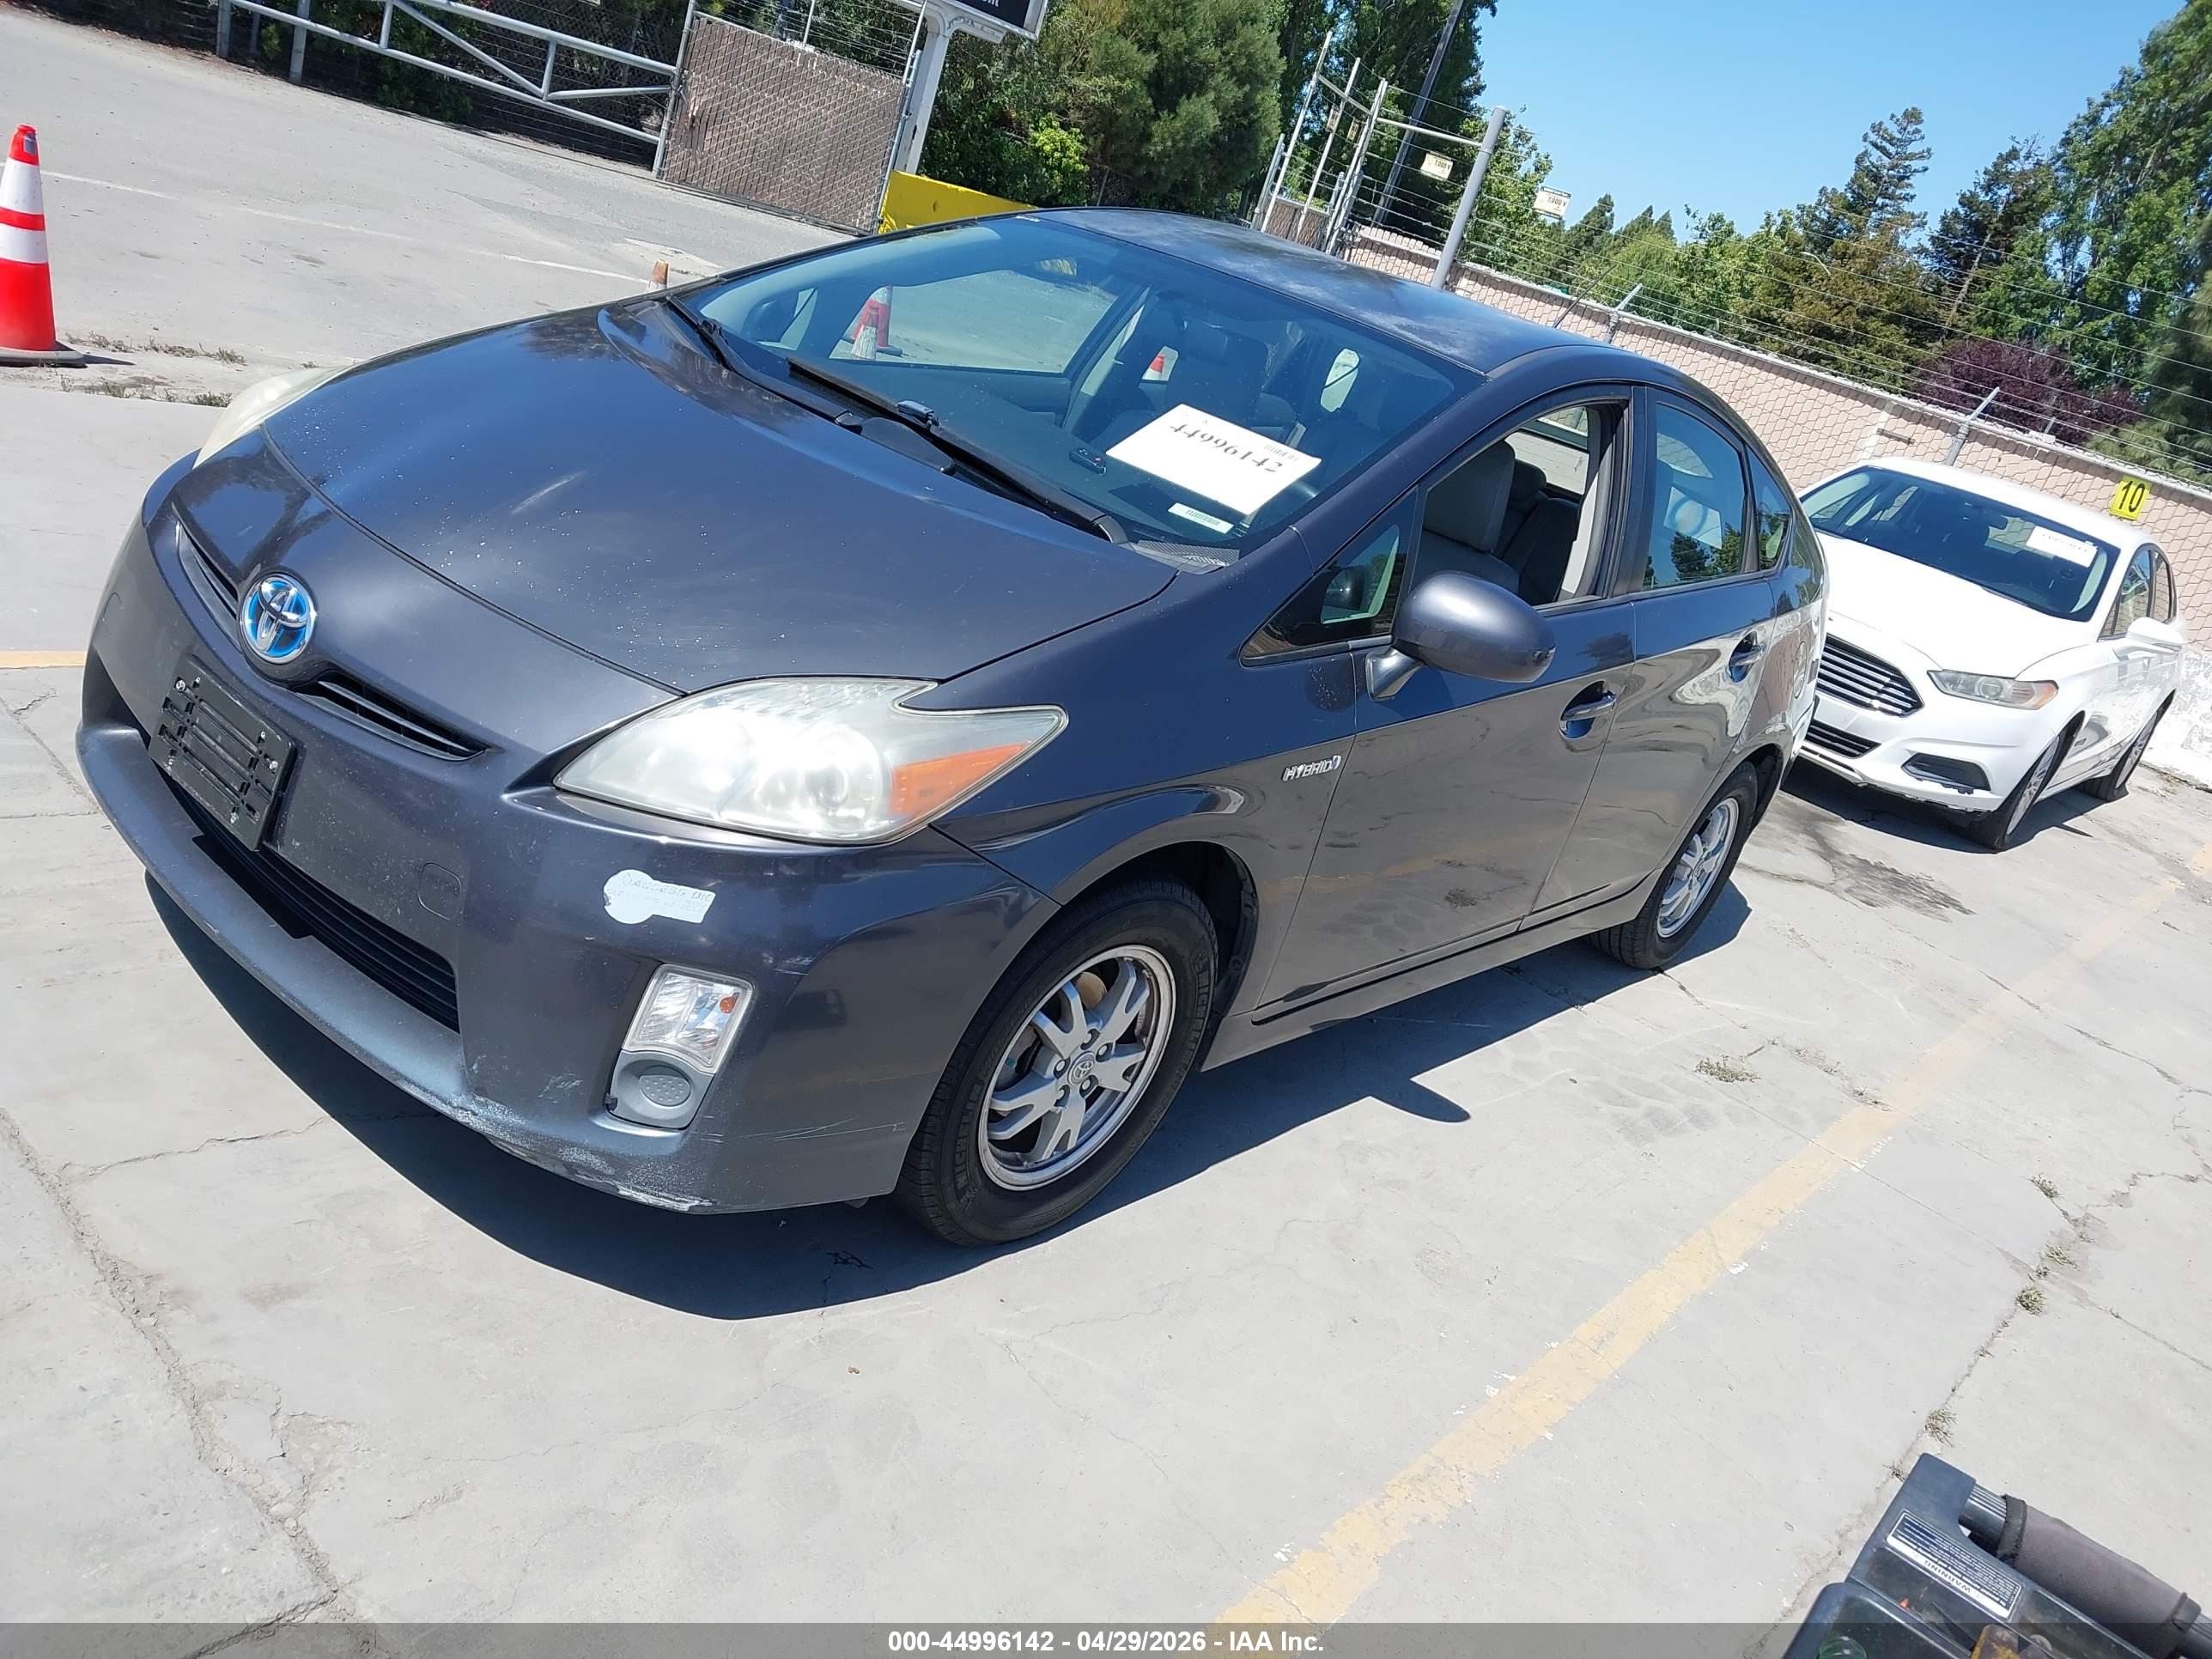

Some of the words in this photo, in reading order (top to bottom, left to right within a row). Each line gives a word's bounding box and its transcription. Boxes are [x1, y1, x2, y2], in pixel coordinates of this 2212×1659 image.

[1170, 423, 1283, 472] 44996142
[2118, 481, 2145, 513] 10
[1282, 759, 1334, 781] HYBRID
[1924, 1559, 1971, 1593] WARNING
